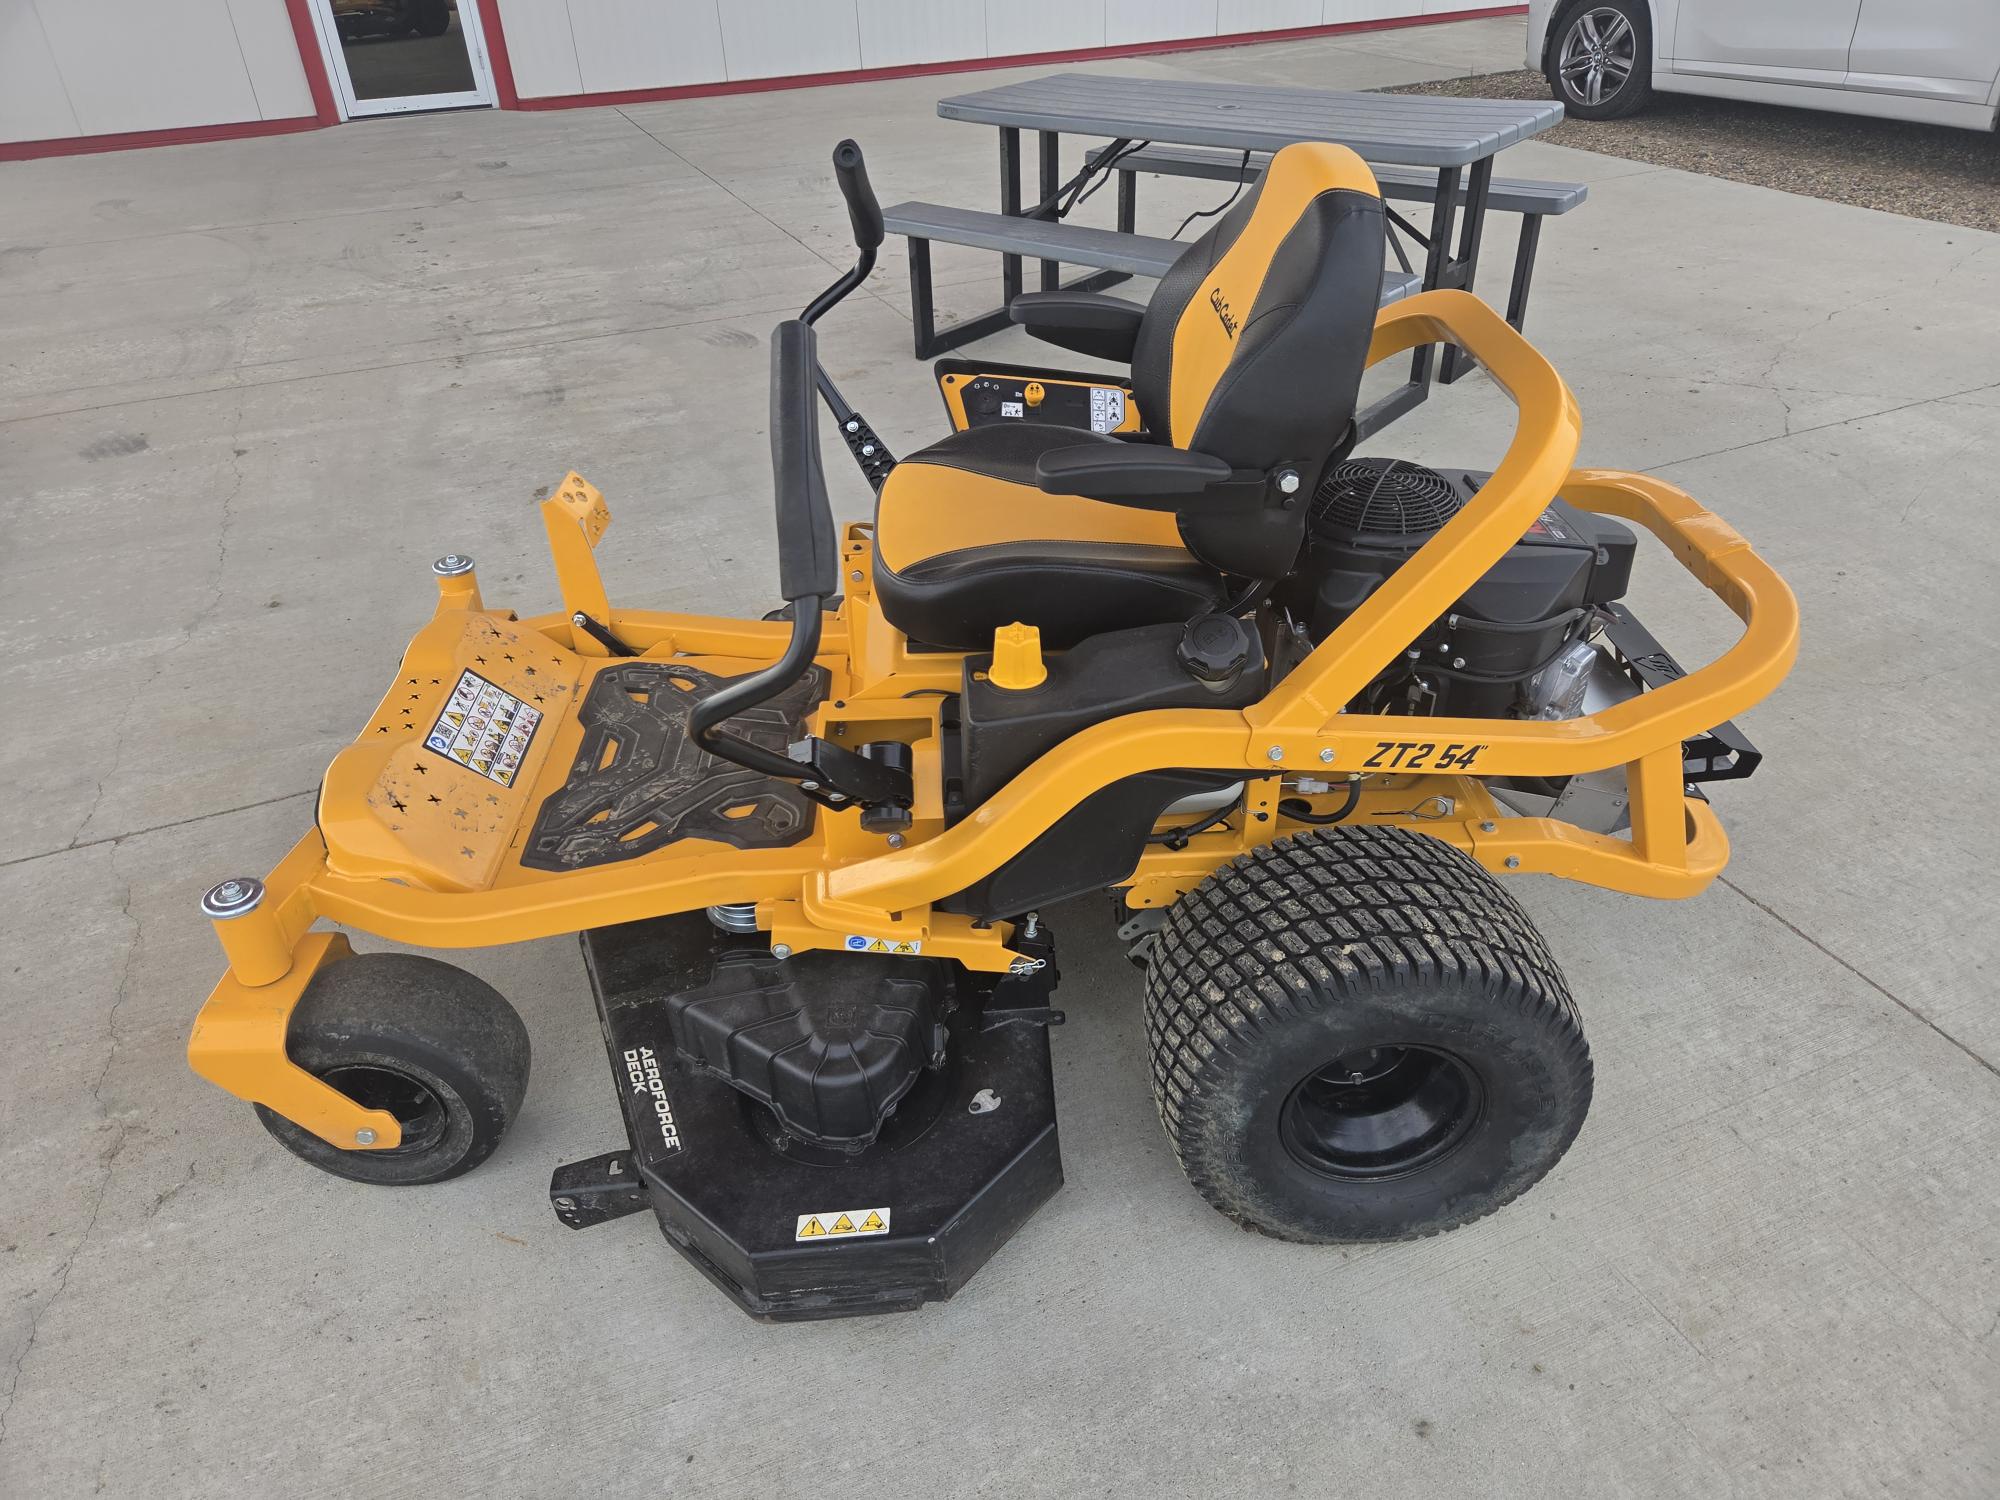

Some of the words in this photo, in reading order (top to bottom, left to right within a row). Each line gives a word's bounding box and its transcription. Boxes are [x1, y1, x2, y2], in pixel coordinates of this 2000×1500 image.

[1219, 303, 1238, 340] Cadet
[1362, 742, 1435, 769] ZT2
[623, 1048, 648, 1095] DECK
[640, 1046, 681, 1151] AEROFORCE
